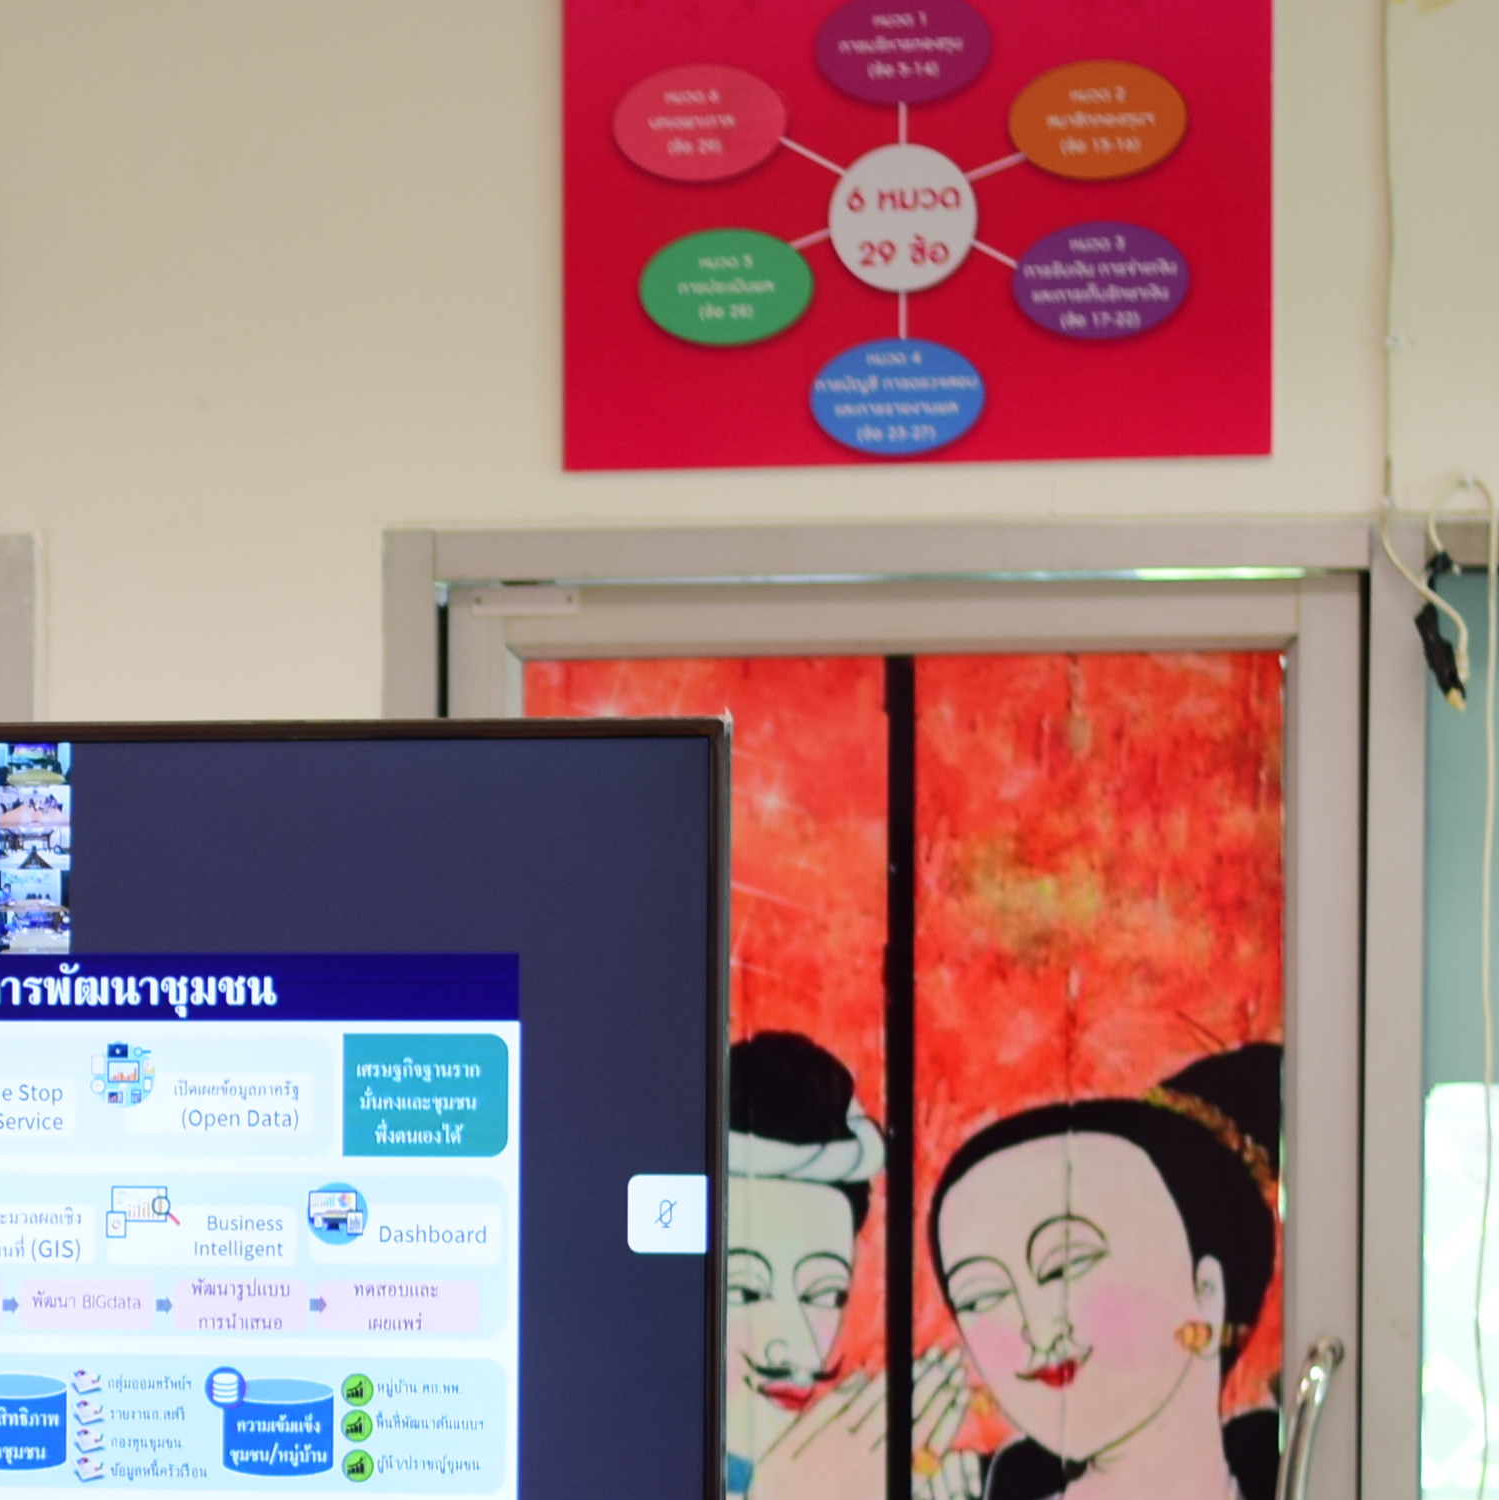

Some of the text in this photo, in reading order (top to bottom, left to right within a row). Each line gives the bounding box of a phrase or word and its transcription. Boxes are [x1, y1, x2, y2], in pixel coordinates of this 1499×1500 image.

[847, 184, 961, 213] 6 หมวด
[859, 234, 948, 267] 29 ข้อ
[18, 1083, 64, 1107] Stop
[181, 1108, 300, 1131] (Open Data)
[207, 1214, 283, 1231] Business
[379, 1225, 487, 1245] Dashboard
[31, 1238, 82, 1262] (GIS)
[194, 1240, 283, 1261] Intelligent
